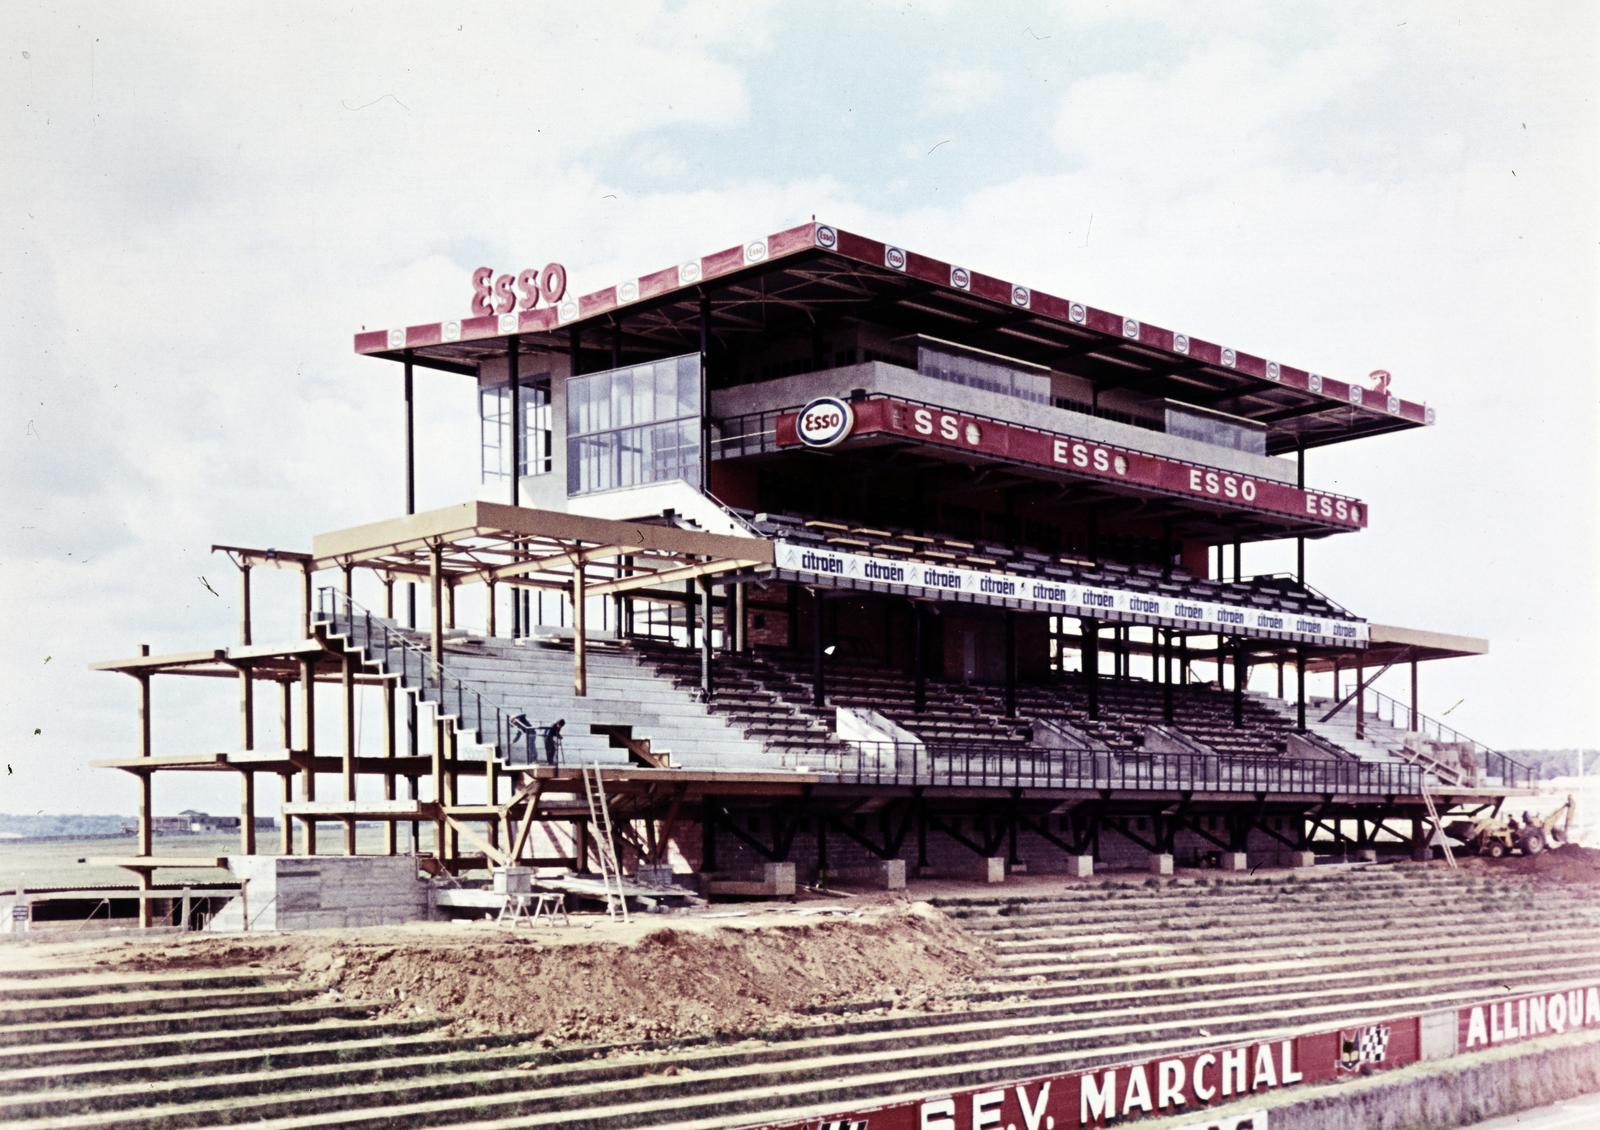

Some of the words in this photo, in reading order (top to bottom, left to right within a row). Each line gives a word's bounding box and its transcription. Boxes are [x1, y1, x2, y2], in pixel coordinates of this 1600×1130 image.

[1190, 469, 1256, 501] ESSO
[802, 551, 843, 574] citroën
[864, 560, 904, 582] citroën
[924, 568, 961, 589] citroën
[980, 576, 1015, 595] citroën
[1033, 583, 1066, 602] citroën
[1082, 589, 1114, 608] citroën
[1080, 1040, 1303, 1124] MARCHAL
